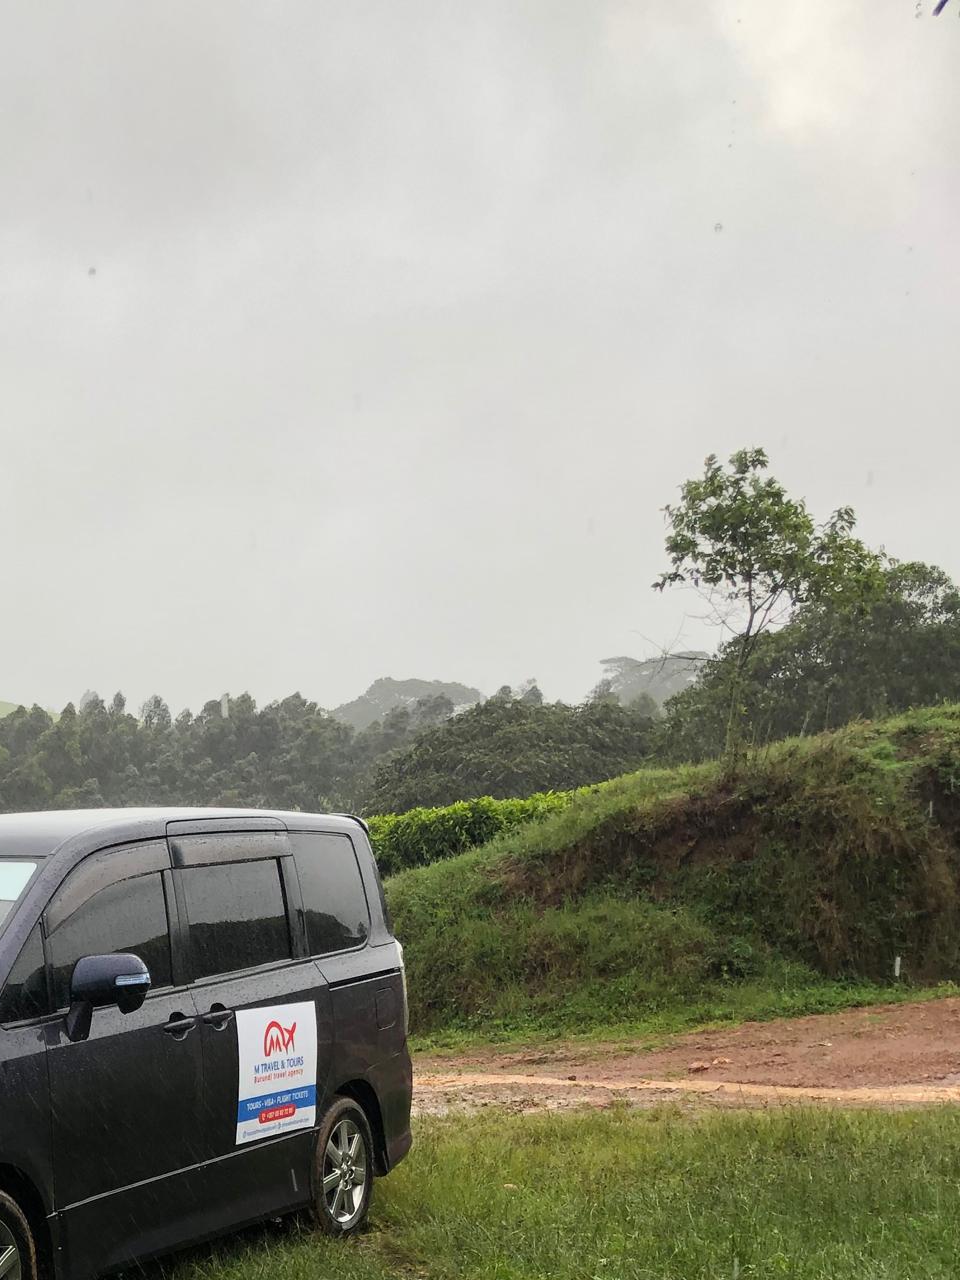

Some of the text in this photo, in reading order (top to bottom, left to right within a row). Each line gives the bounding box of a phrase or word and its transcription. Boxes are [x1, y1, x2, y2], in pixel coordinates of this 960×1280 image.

[254, 1056, 304, 1074] M TRAVEL & TOURS
[254, 1073, 272, 1083] Burundi
[288, 1068, 303, 1078] agency
[247, 1090, 309, 1111] TOURS VISA FLIGHT TICKETS
